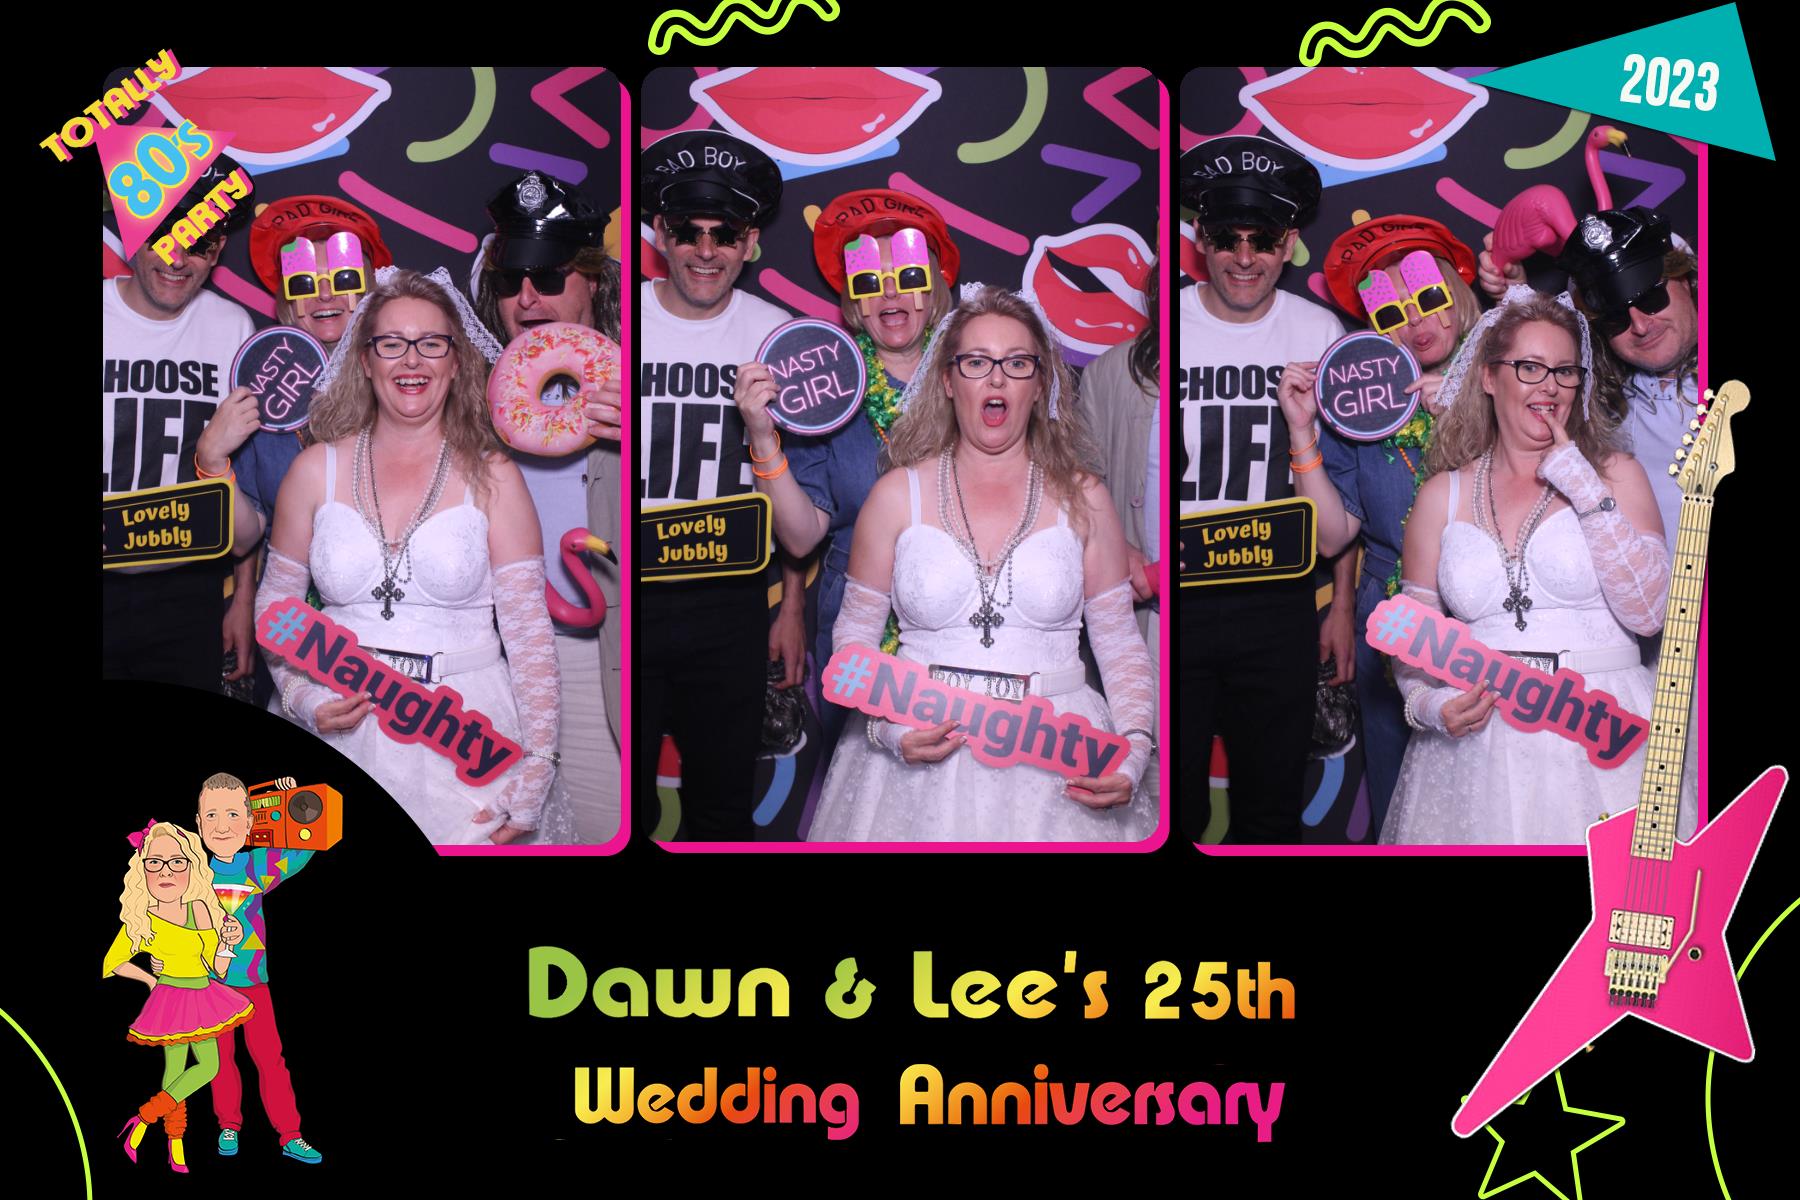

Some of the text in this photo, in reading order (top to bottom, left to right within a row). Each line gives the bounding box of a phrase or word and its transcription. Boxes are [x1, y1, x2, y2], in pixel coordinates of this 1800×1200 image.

[704, 146, 746, 171] BOY
[1242, 151, 1285, 175] BOY
[251, 337, 294, 395] NASTY
[767, 340, 840, 379] NASTY
[1329, 355, 1401, 386] NASTY
[103, 359, 219, 397] HOOSE
[265, 360, 321, 419] GIRL
[641, 362, 738, 400] HOOS
[779, 371, 856, 414] GIRL
[1333, 383, 1407, 418] GIRL
[122, 500, 190, 527] Lovely
[656, 514, 726, 540] Lovely
[124, 527, 192, 550] Jubbly
[1202, 519, 1272, 545] Lovely
[658, 541, 728, 563] Jubbly
[1203, 545, 1274, 568] Jubbly
[265, 606, 513, 779] #Naughty
[984, 674, 1024, 699] TOY
[1376, 605, 1642, 760] #Naughty
[831, 654, 1120, 779] #Naughty
